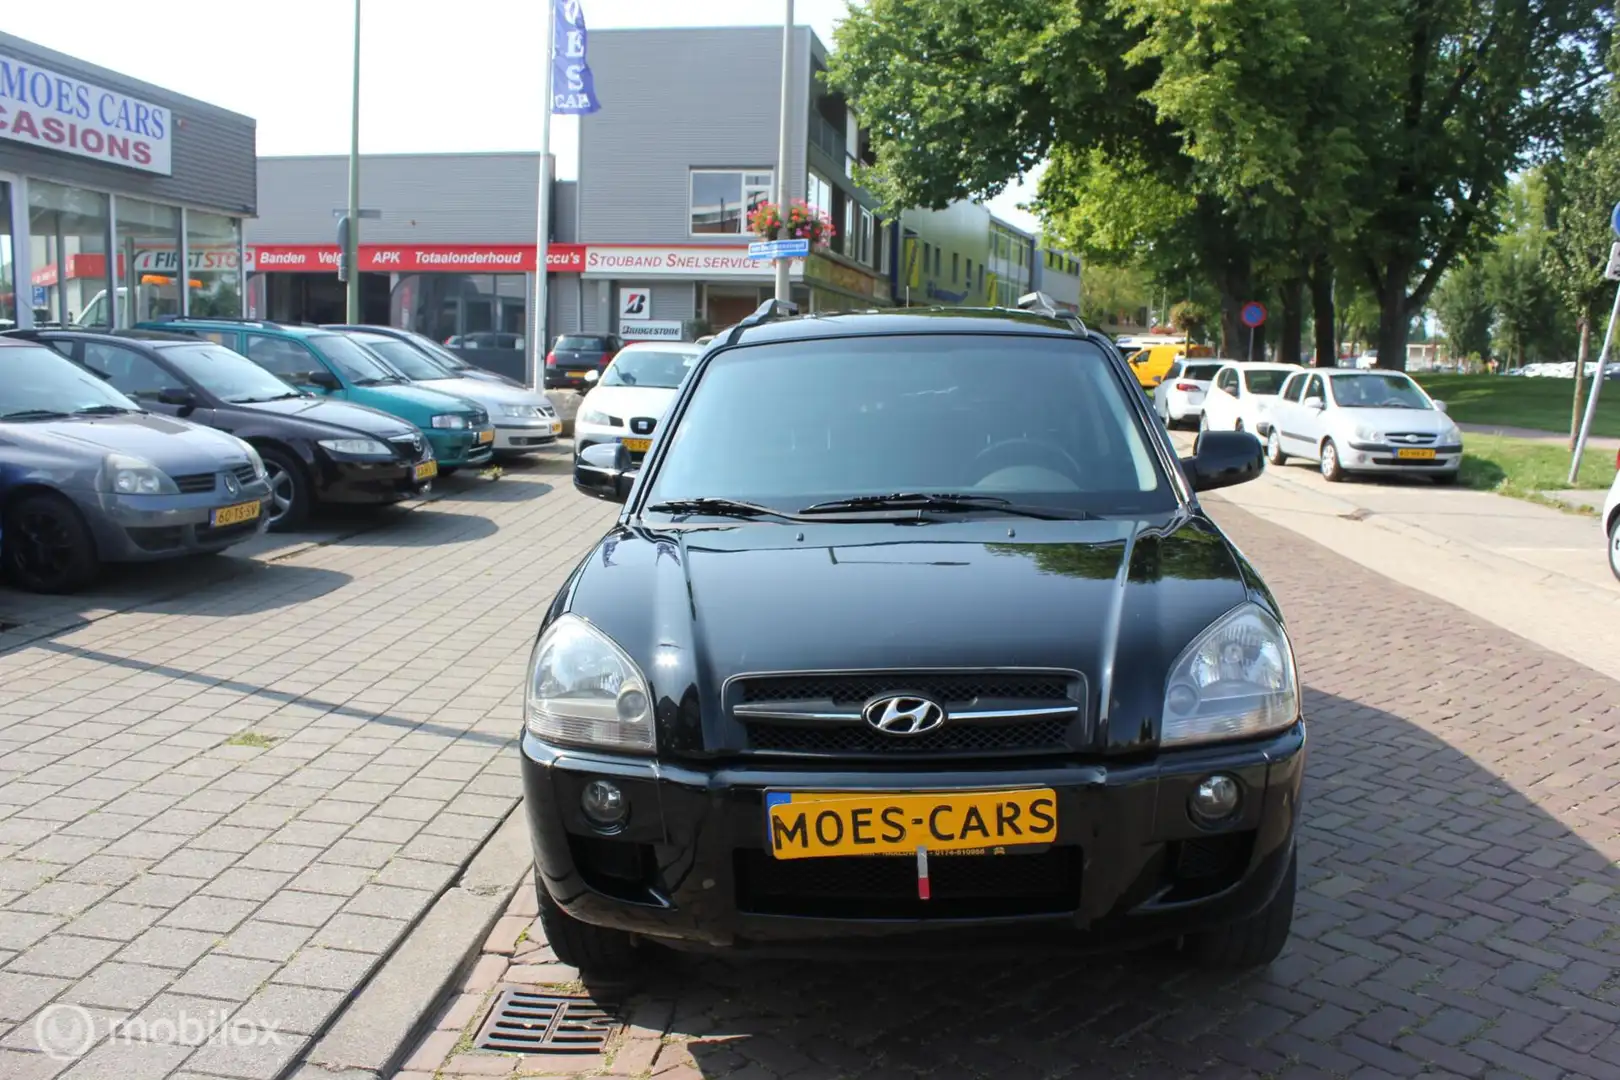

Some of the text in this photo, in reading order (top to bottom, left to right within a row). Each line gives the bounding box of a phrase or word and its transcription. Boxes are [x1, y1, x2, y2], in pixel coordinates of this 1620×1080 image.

[0, 60, 165, 140] MOES CARS
[260, 251, 306, 264] Banden
[372, 251, 400, 263] APK
[415, 251, 522, 265] Totaalonderhoud
[537, 251, 580, 265] ccu's
[588, 252, 662, 267] STOUBAND
[622, 325, 680, 336] BRIDGESTONE
[772, 798, 1056, 851] MOES-CARS
